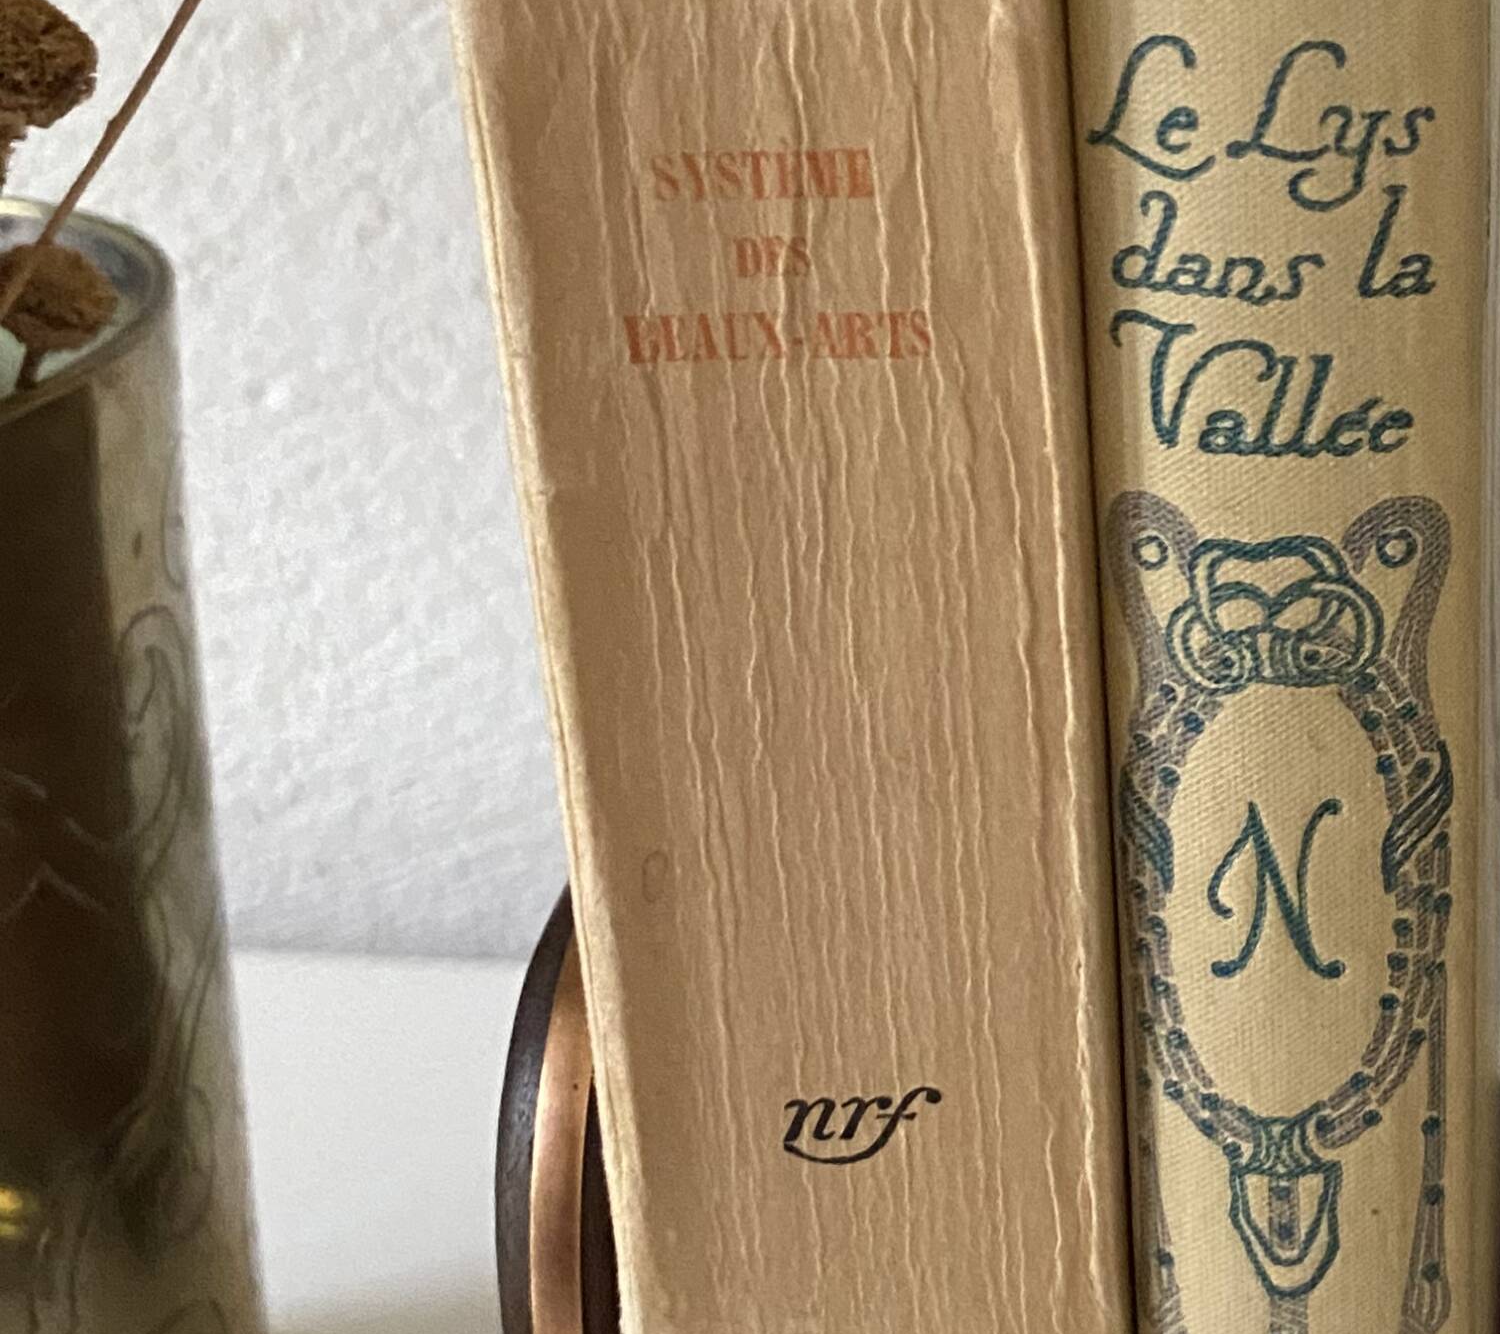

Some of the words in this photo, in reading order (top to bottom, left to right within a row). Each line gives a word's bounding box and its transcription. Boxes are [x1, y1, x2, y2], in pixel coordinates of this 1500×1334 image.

[1086, 34, 1216, 182] Le
[1226, 40, 1436, 212] Lys
[1112, 190, 1326, 306] dans
[1357, 184, 1437, 299] la
[1110, 309, 1415, 457] Vallée
[1207, 797, 1346, 979] N
[783, 1086, 942, 1165] nrf
